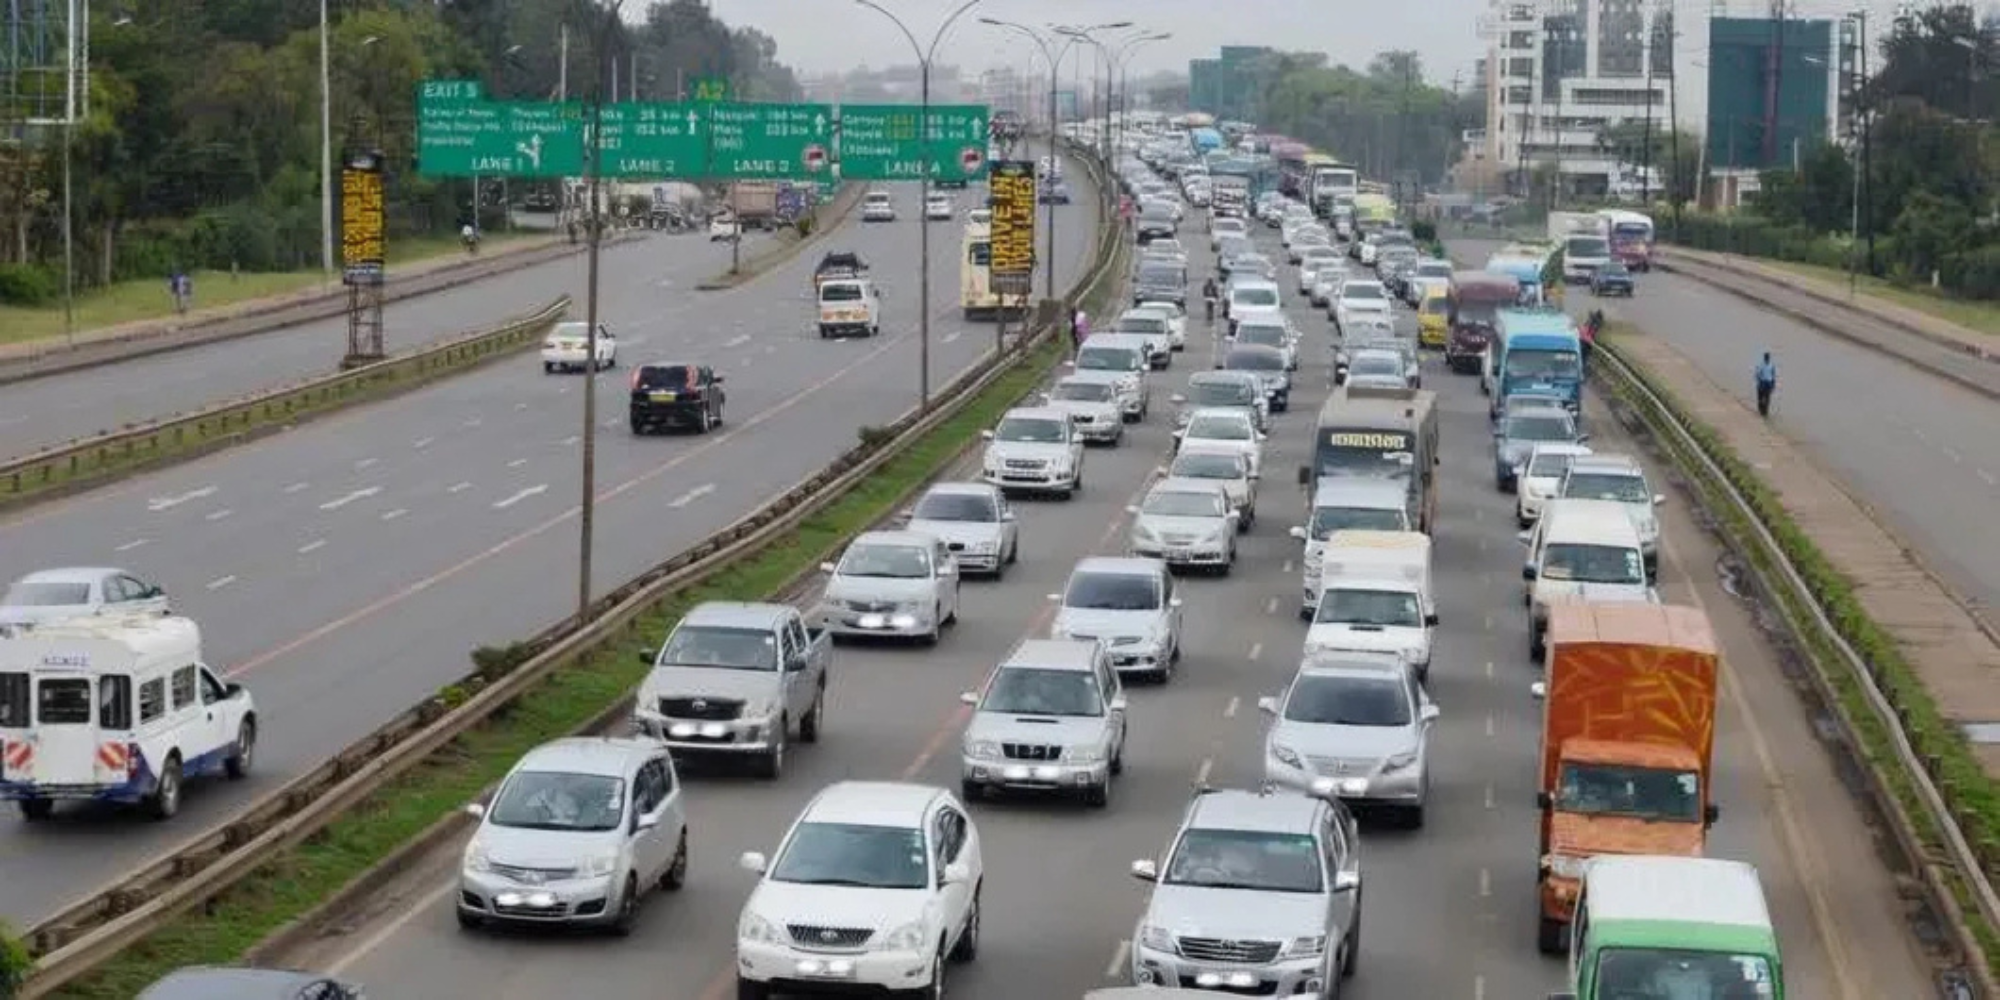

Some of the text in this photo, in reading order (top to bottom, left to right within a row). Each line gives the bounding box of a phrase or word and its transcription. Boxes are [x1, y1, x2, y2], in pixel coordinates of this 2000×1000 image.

[424, 83, 459, 98] EXIT
[698, 82, 725, 100] A2
[471, 157, 512, 171] LANE
[620, 159, 675, 172] LANE 2
[734, 160, 776, 172] LANE
[884, 160, 923, 175] LANE
[991, 176, 1013, 271] DRIVE IN
